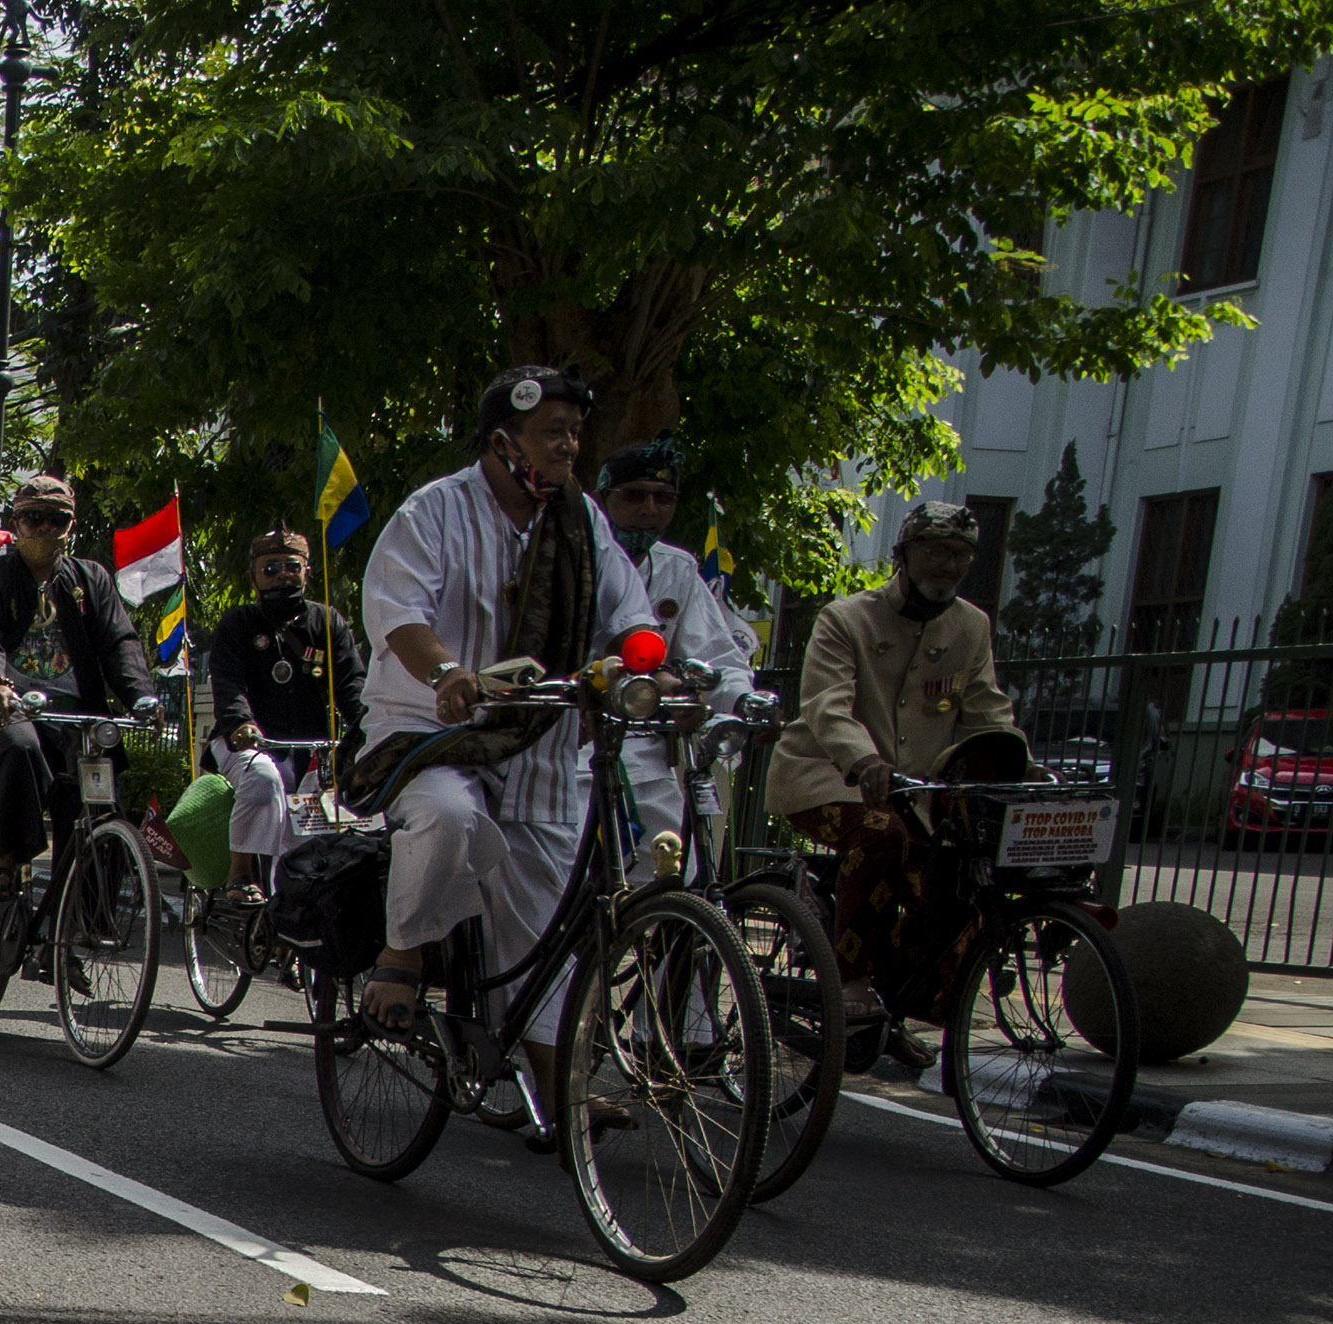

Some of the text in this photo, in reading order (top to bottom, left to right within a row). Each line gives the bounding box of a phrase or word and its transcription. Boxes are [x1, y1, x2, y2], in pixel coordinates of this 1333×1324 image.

[1024, 811, 1098, 825] STOP COVID 19
[1022, 825, 1093, 839] STOP NARKOBA
